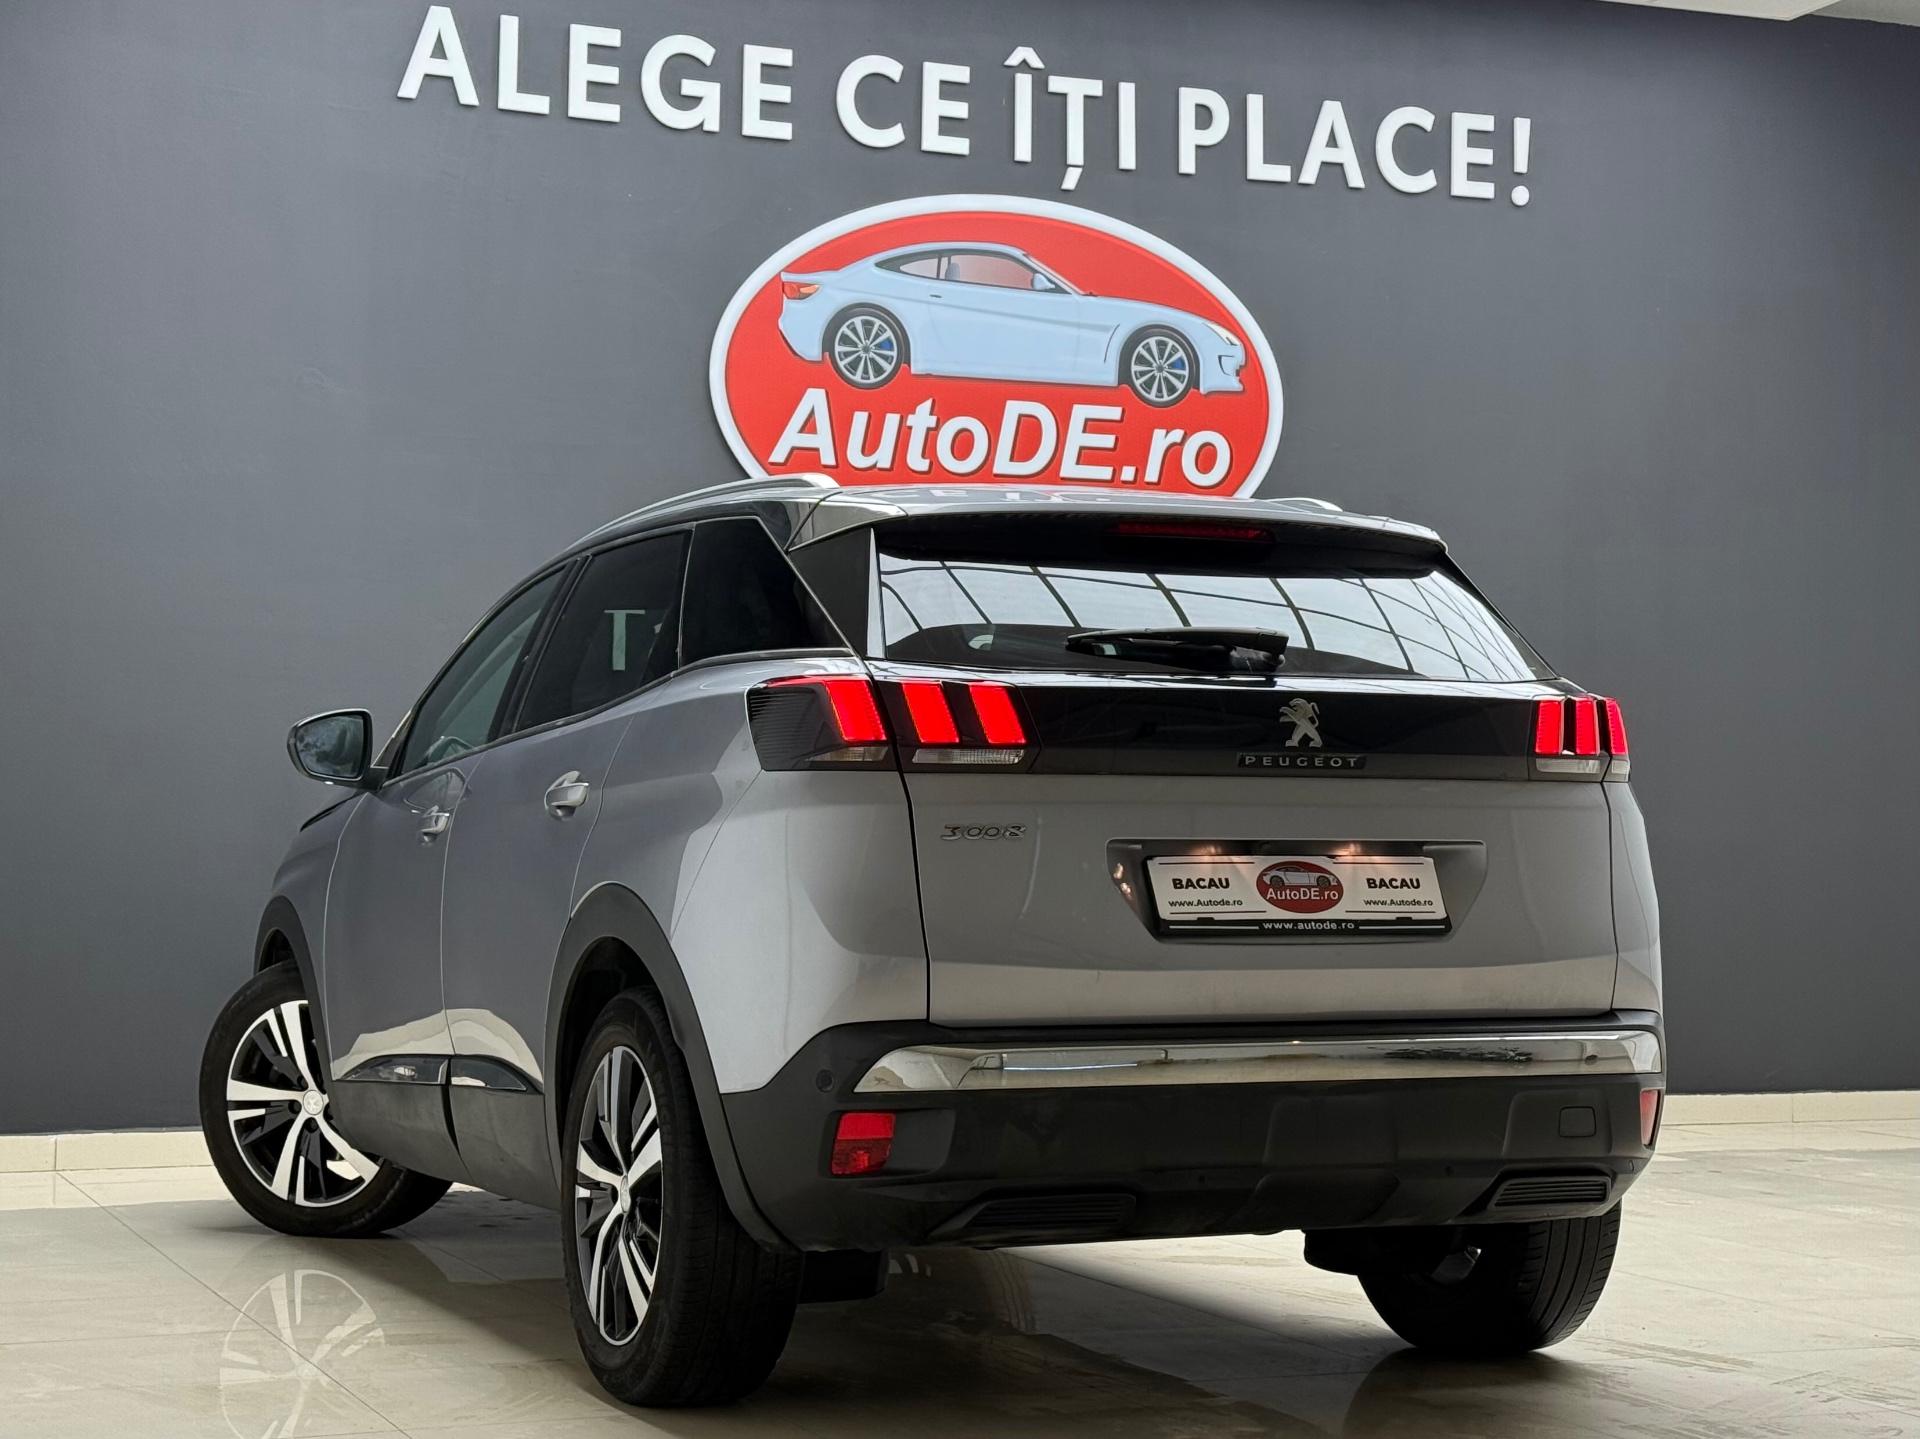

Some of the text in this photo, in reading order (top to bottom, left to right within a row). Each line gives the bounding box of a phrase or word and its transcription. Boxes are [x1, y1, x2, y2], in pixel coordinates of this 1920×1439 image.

[397, 5, 1532, 207] ALEGE CE ÎȚI PLACE!
[768, 387, 1232, 487] AutoDE.ro
[1244, 755, 1358, 768] PEUGEOT
[941, 824, 1026, 840] 3008
[1172, 878, 1230, 890] BACAU
[1366, 878, 1421, 890] BACAU
[1266, 887, 1340, 900] AutoDE.ro
[1168, 898, 1244, 908] www.Autode.ro
[1363, 898, 1434, 907] www.Autode.ro
[1262, 921, 1355, 931] www.autode.ro
